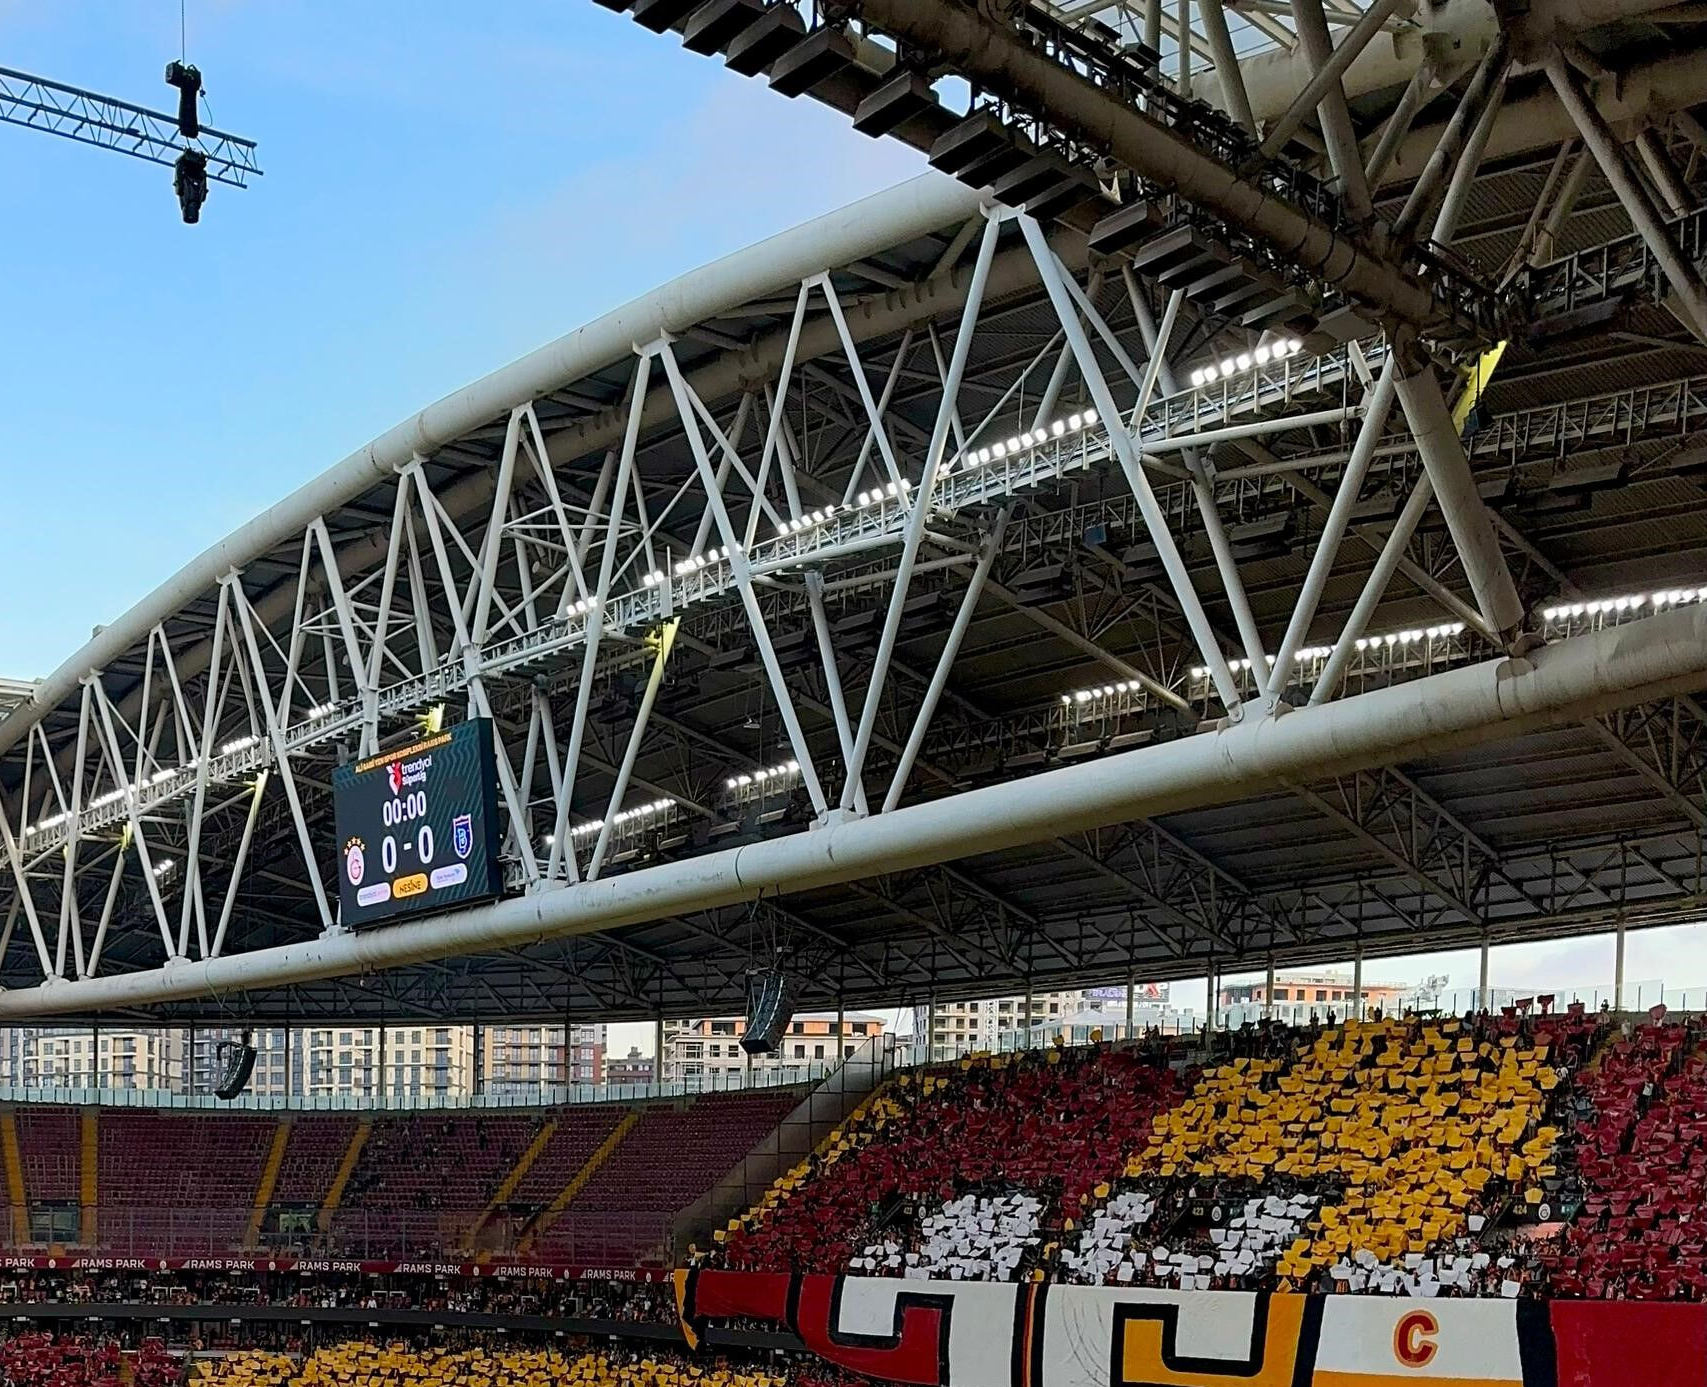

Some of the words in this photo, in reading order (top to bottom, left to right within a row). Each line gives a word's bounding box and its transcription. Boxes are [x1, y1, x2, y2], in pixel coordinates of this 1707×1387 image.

[402, 755, 432, 775] trendyol
[383, 790, 426, 826] 00:00
[382, 836, 397, 873] 0
[418, 825, 434, 864] 0
[5, 1258, 35, 1268] PARK
[81, 1259, 113, 1269] RAMS
[116, 1259, 145, 1269] PARK
[191, 1260, 222, 1270] RAMS
[225, 1260, 255, 1270] PARK
[299, 1261, 330, 1271] RAMS
[333, 1262, 361, 1272] PARK
[403, 1264, 432, 1274] RAMS
[435, 1265, 461, 1275] PARK
[501, 1267, 526, 1278] RAMS
[529, 1268, 553, 1279] PARK
[588, 1270, 610, 1280] RAMS
[613, 1271, 636, 1281] PARK
[1393, 1309, 1440, 1368] C
